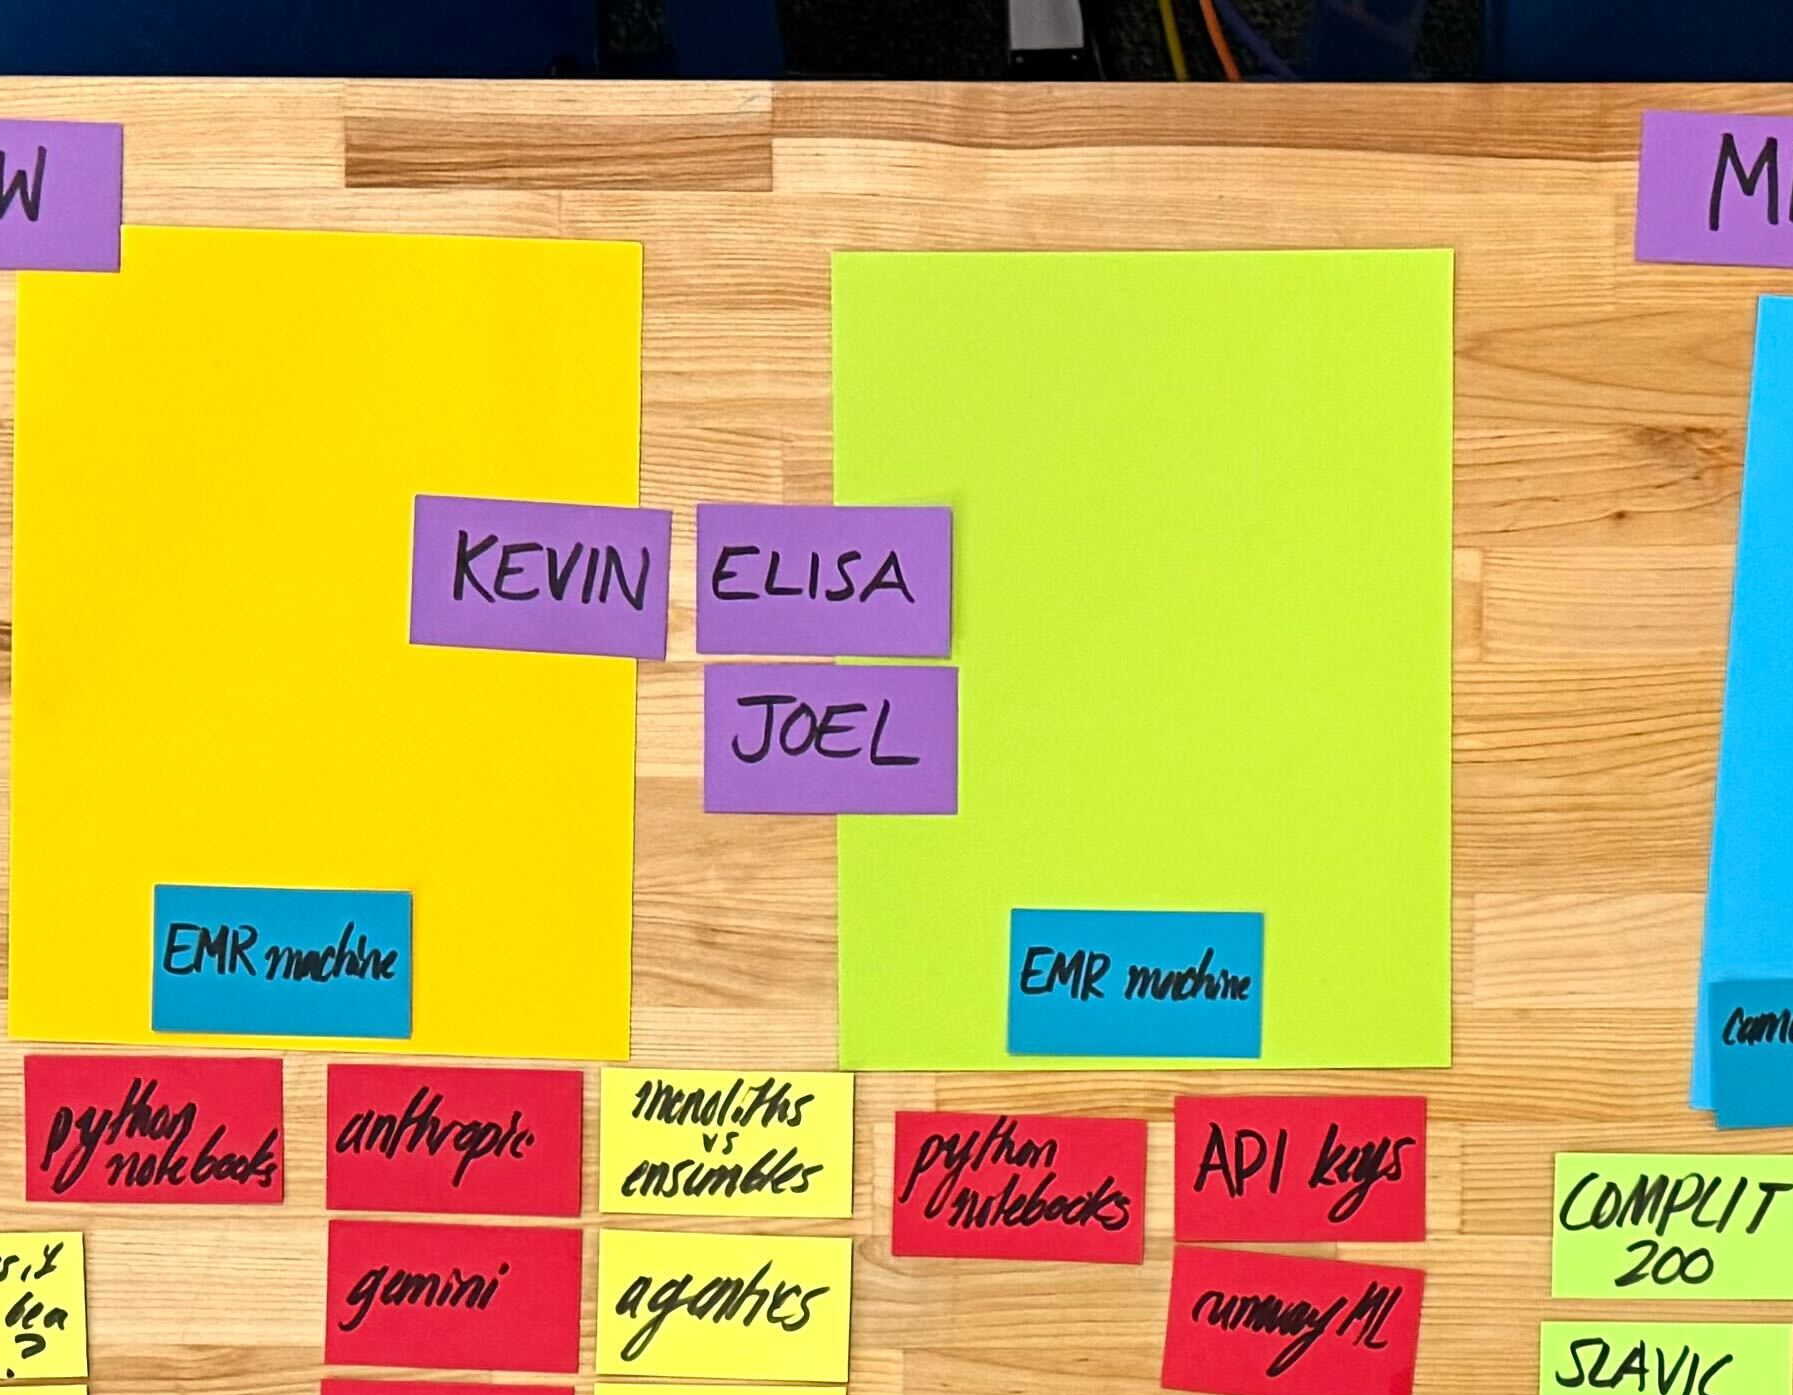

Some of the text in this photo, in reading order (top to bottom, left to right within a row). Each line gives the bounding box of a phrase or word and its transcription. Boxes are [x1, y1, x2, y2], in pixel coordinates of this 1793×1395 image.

[454, 531, 649, 610] KEVIN
[712, 546, 914, 602] ELISA
[732, 696, 918, 765] JOEL
[164, 924, 257, 975] EMR
[1021, 947, 1109, 1000] EMR
[41, 1078, 196, 1194] python
[336, 1088, 533, 1185] anthropic
[703, 1132, 739, 1155] vs
[900, 1115, 1057, 1218] python
[1195, 1124, 1414, 1222] API keys
[1560, 1173, 1793, 1236] COMPLIT
[1615, 1240, 1713, 1286] 200
[340, 1265, 508, 1331] gemini
[1337, 1281, 1401, 1349] ML
